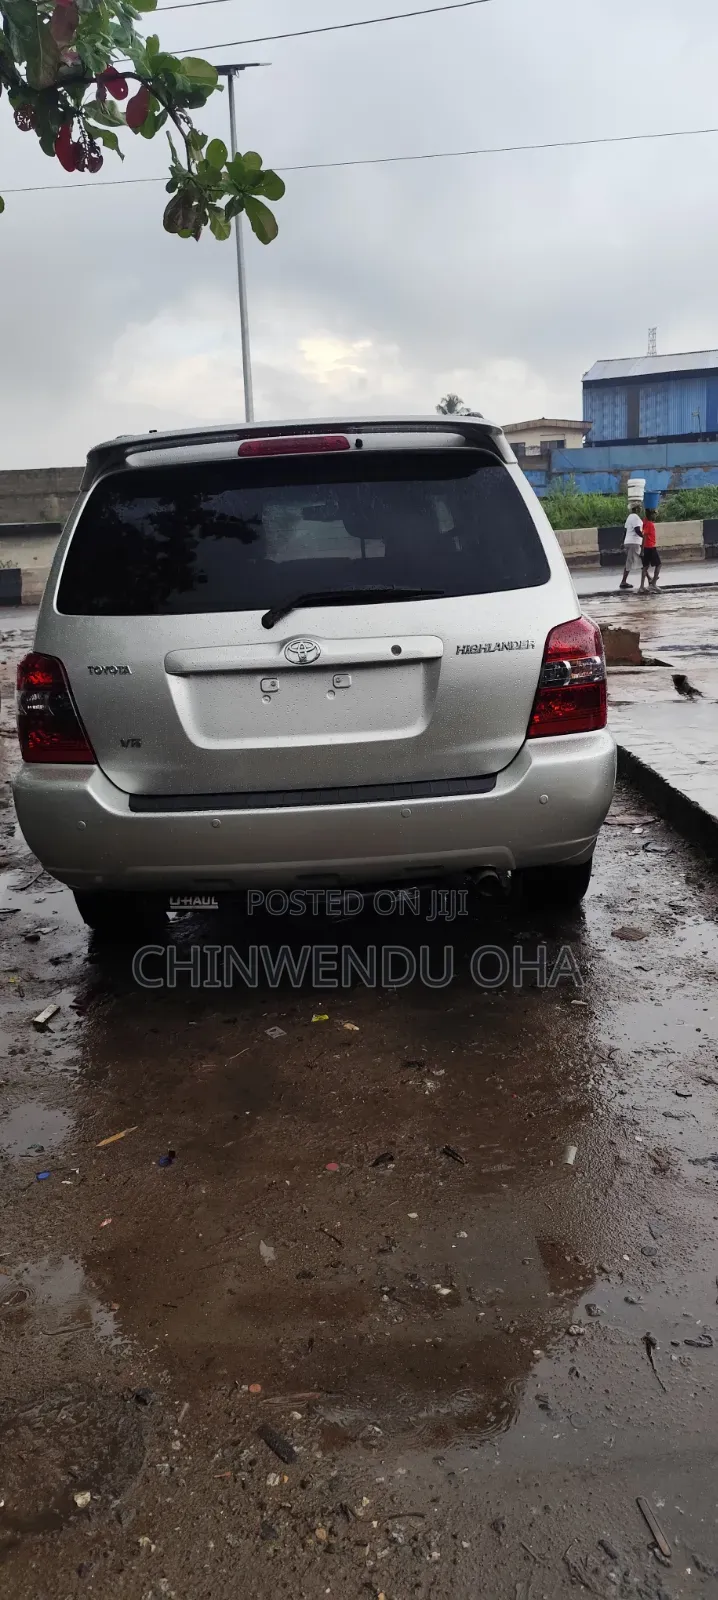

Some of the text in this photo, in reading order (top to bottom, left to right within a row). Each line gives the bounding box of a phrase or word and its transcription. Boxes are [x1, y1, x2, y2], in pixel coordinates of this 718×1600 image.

[455, 639, 535, 655] HIGHLANDER
[87, 665, 132, 675] TOYOTA
[120, 738, 141, 748] V6
[169, 896, 218, 906] U-HAUL
